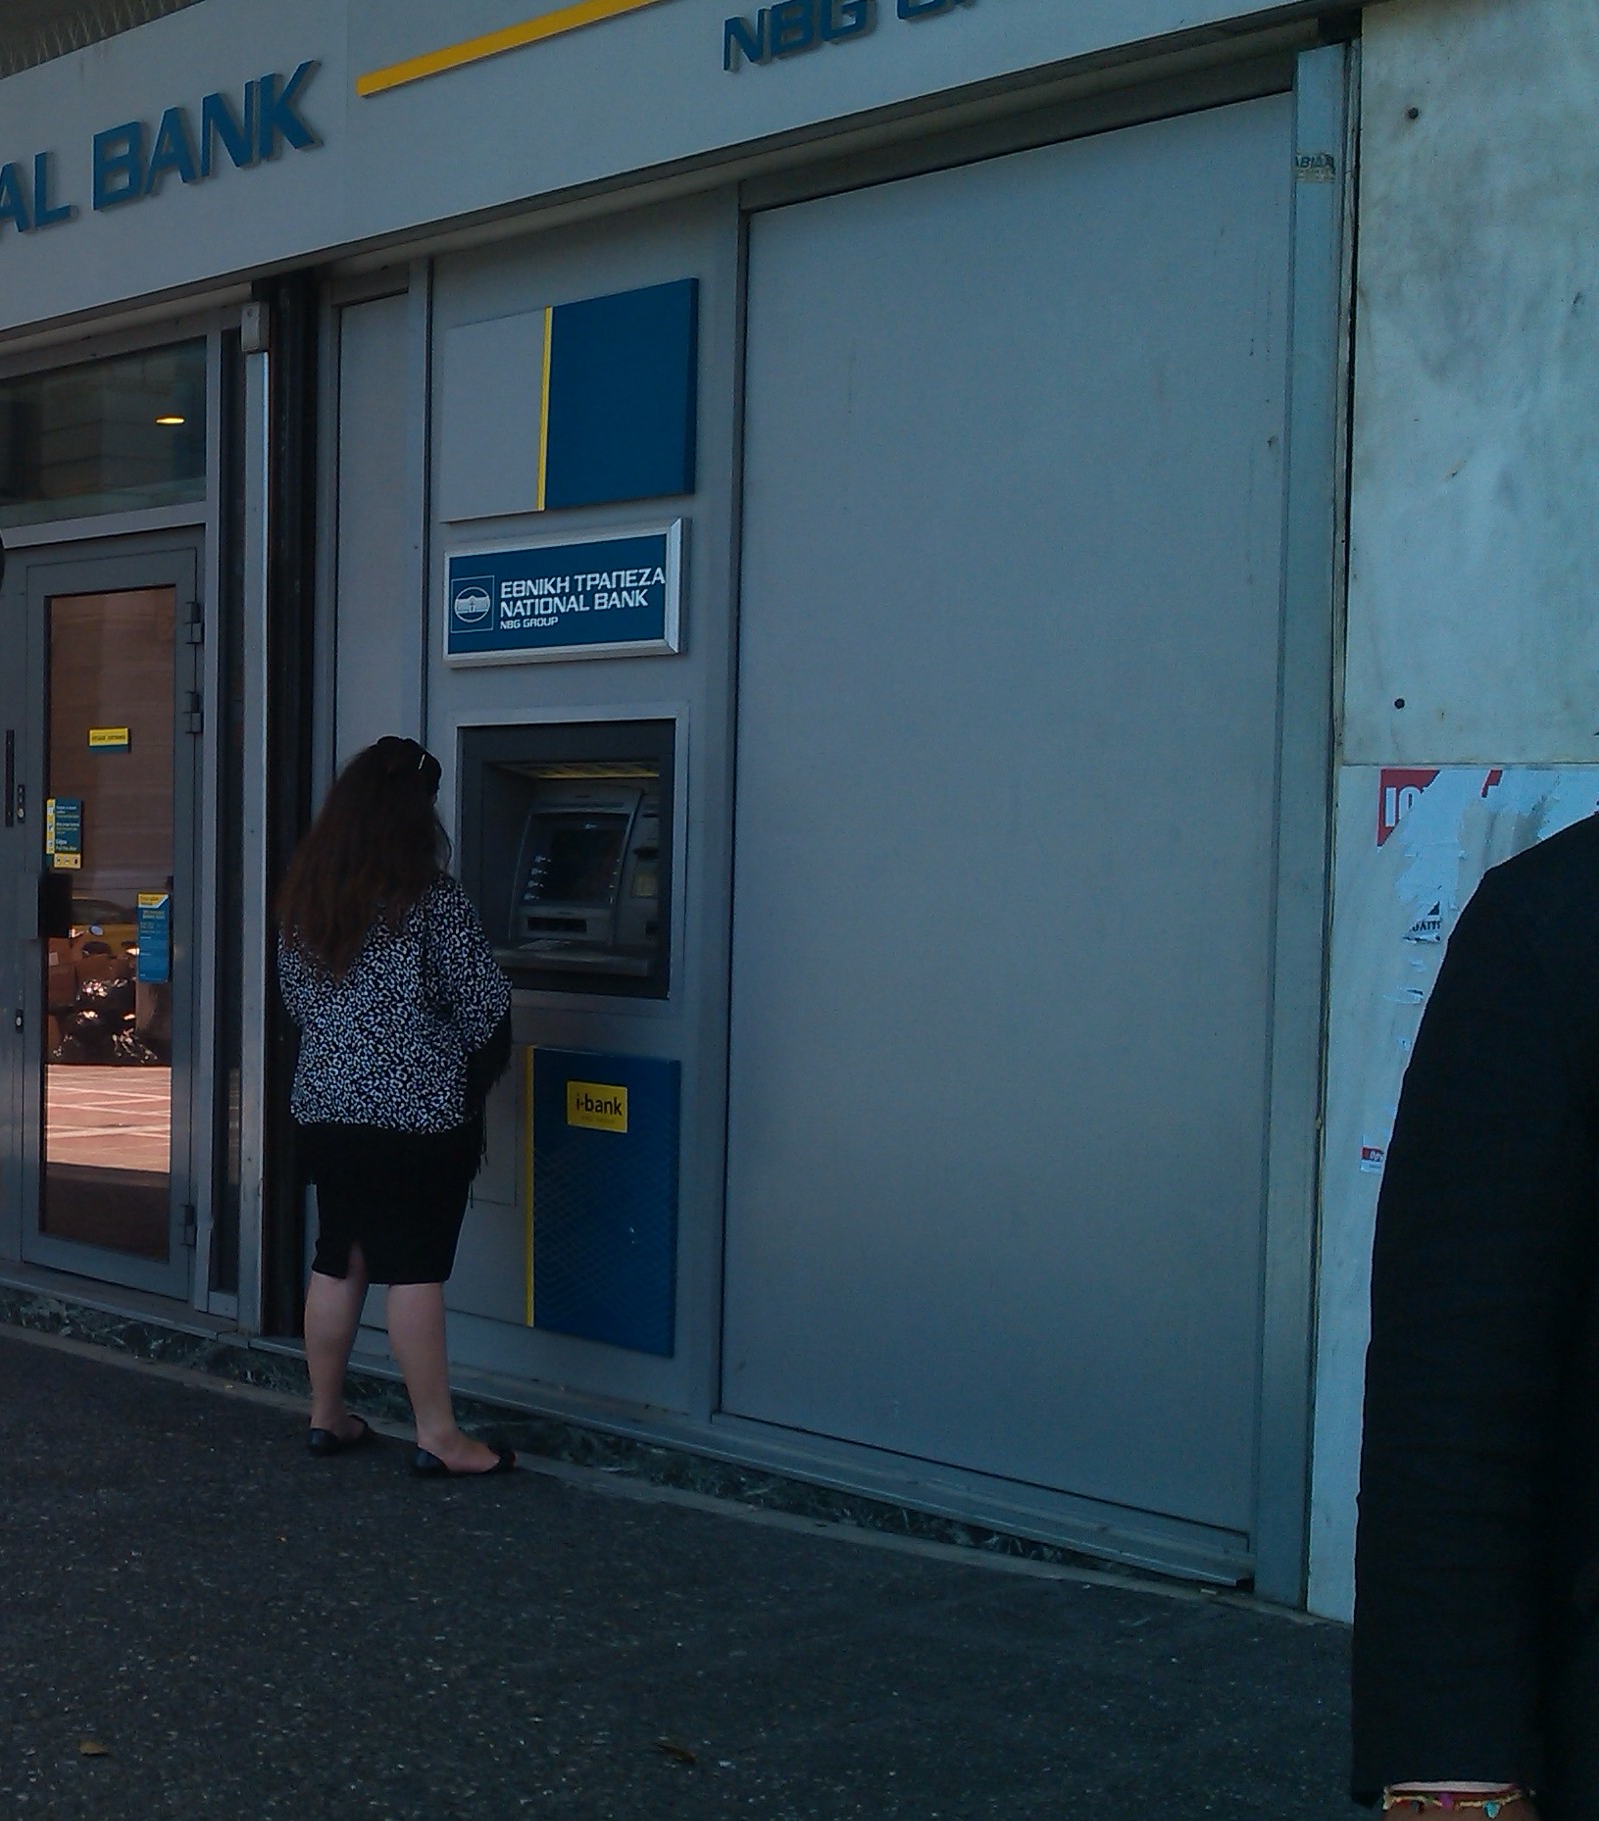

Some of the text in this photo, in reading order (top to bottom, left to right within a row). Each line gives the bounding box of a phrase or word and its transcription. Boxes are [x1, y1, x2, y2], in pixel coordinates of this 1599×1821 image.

[93, 59, 322, 212] BANK
[500, 567, 666, 599] ΕΘΝΙΚΗ ΤΡΑΠΕΖΑ
[500, 588, 649, 619] NATIONAL BANK
[500, 616, 559, 630] NBG GROUP
[576, 1093, 623, 1116] i-bank
